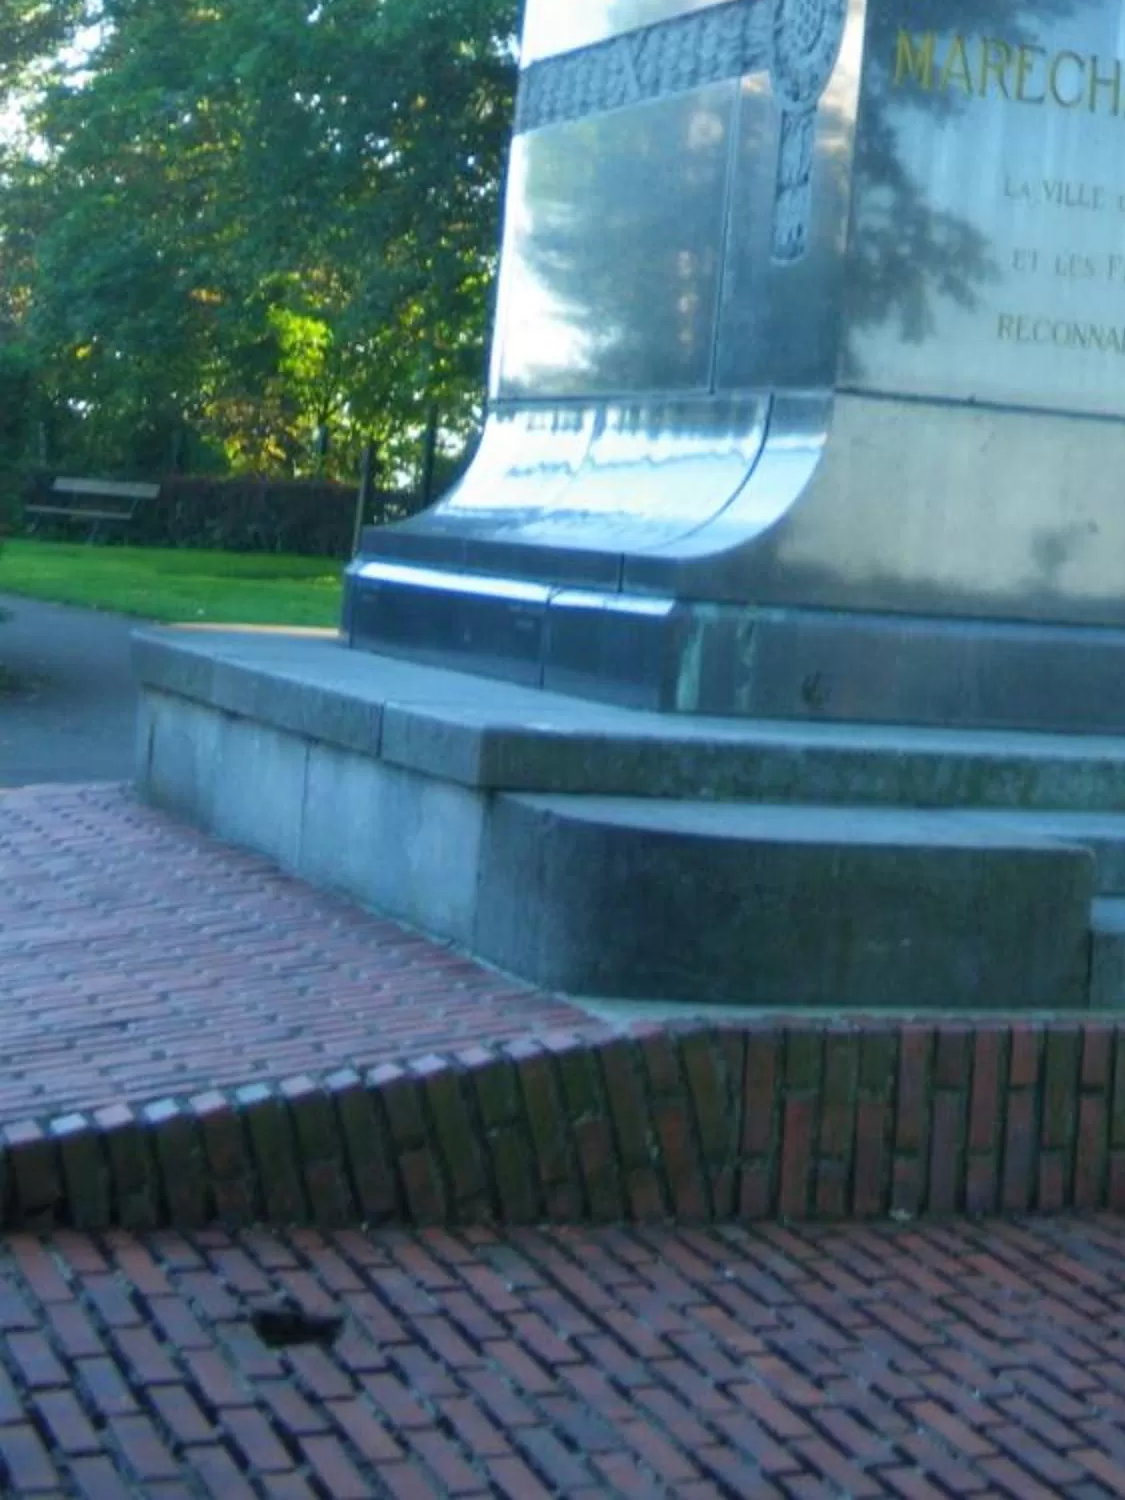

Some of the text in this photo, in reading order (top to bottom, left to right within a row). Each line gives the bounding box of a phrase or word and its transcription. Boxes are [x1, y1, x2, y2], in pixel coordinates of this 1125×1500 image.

[1042, 179, 1105, 212] VILLE
[1012, 248, 1039, 272] ET
[1054, 251, 1097, 278] LES
